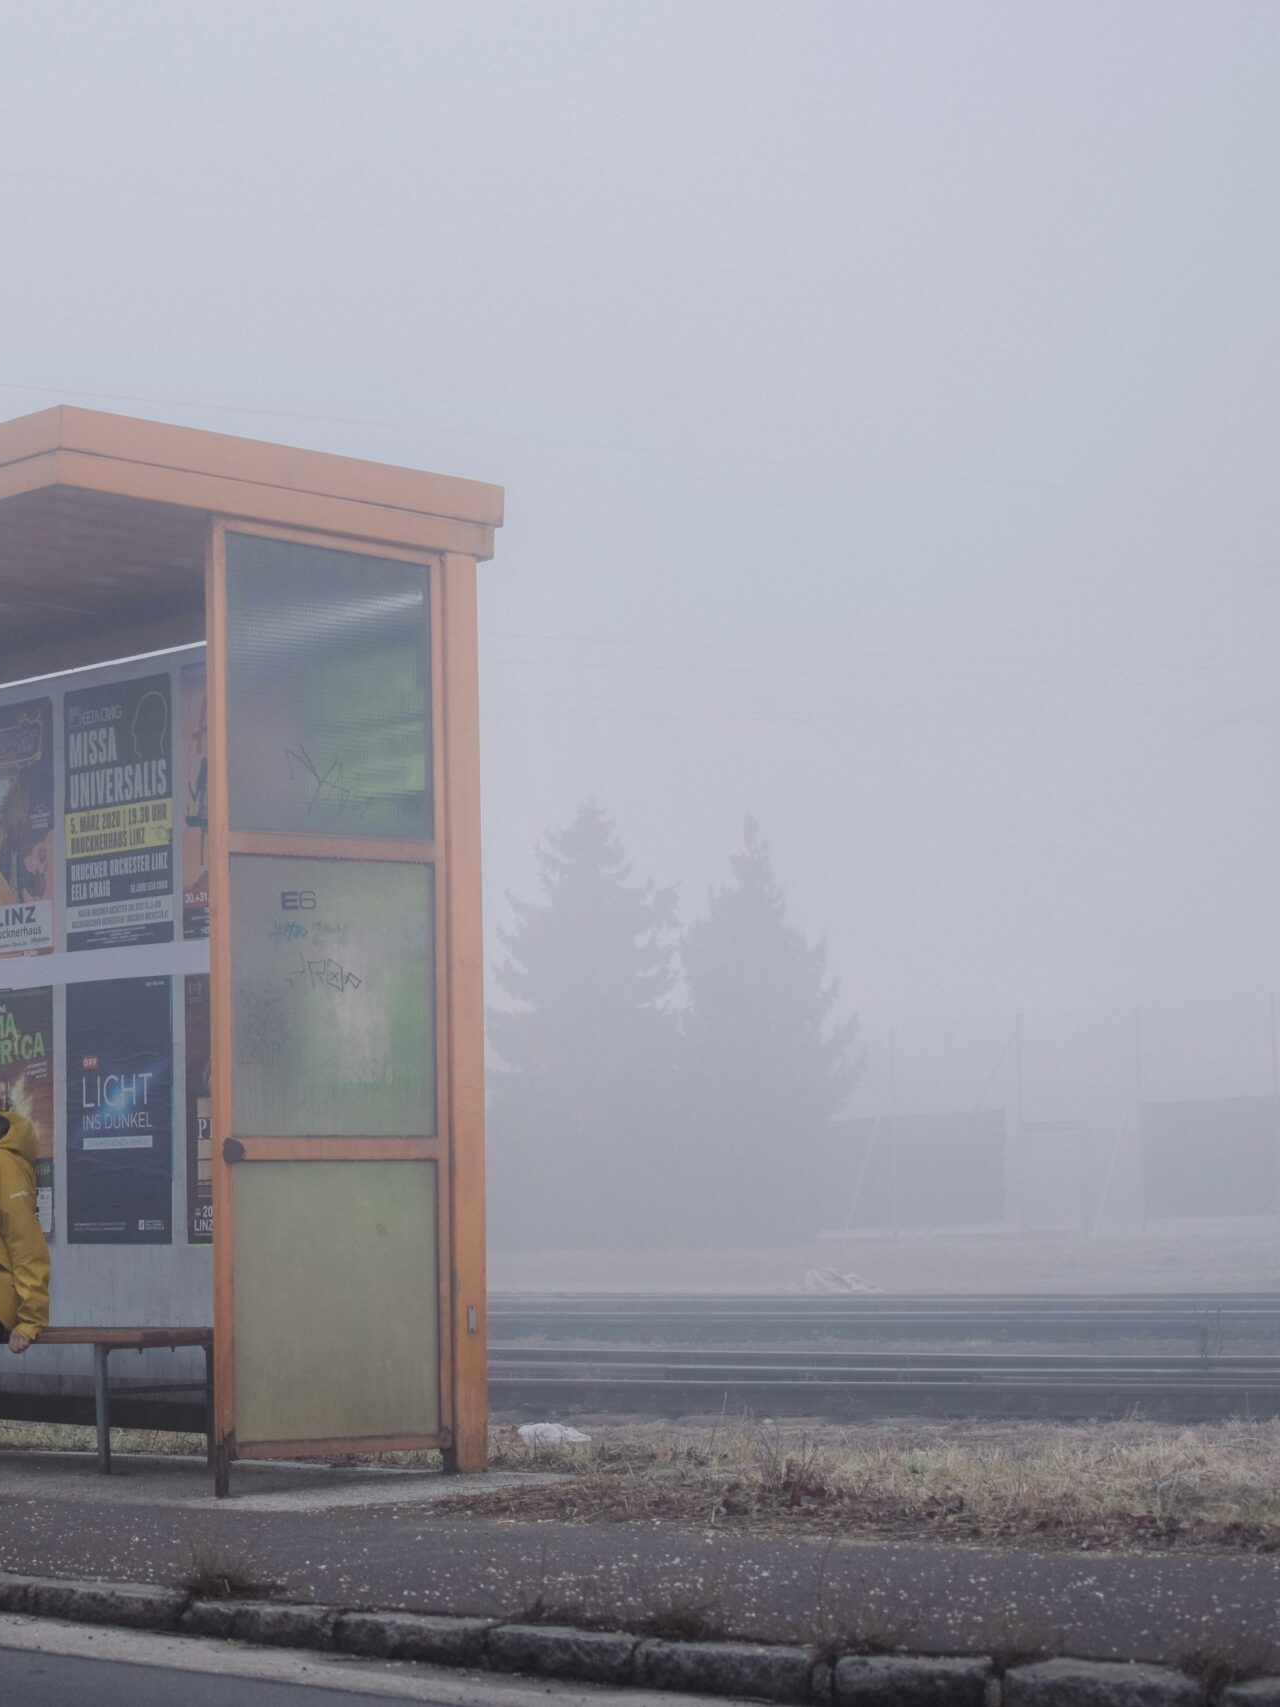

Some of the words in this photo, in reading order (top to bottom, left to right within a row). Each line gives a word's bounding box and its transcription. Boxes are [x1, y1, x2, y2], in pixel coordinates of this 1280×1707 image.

[69, 726, 117, 769] MISSA
[69, 758, 167, 810] UNIVERSALIS
[70, 817, 78, 834] 5.
[80, 811, 100, 833] MÄRZ
[102, 810, 121, 830] 2020
[128, 806, 150, 825] 19.30
[152, 803, 167, 821] UHR
[71, 830, 127, 855] BRUCKNERHAUS
[129, 827, 146, 847] LINZ
[71, 861, 108, 882] BRUCKNER
[109, 854, 150, 876] ORCHESTER
[152, 851, 168, 871] LINZ
[71, 882, 88, 901] EELA
[89, 879, 111, 899] CRAIG
[281, 890, 317, 910] E6
[83, 1058, 97, 1066] ORF
[82, 1073, 153, 1108] LICHT
[82, 1114, 102, 1130] INS
[104, 1111, 153, 1129] DUNKEL
